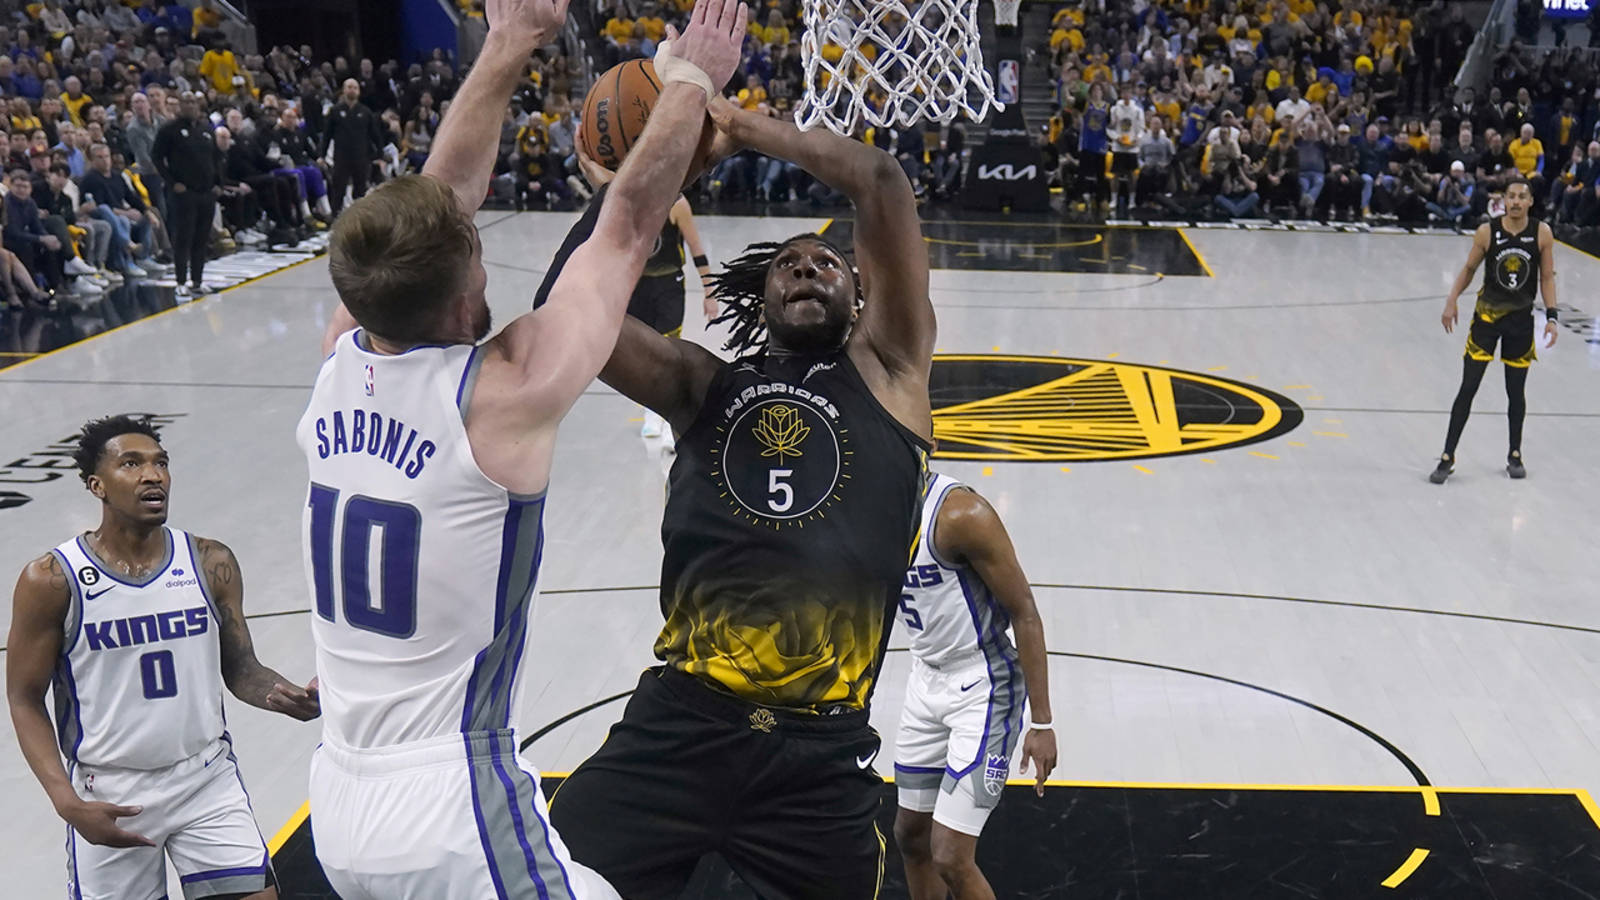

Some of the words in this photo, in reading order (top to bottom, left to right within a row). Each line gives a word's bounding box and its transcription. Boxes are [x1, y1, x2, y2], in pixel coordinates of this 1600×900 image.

[1508, 273, 1518, 288] 3
[725, 383, 840, 420] WARRIORS
[316, 409, 436, 479] SABONIS
[767, 469, 794, 512] 5
[82, 569, 96, 584] 6
[308, 481, 422, 639] 10
[165, 578, 197, 588] dialpad
[84, 606, 208, 651] KINGS
[140, 649, 178, 700] 0
